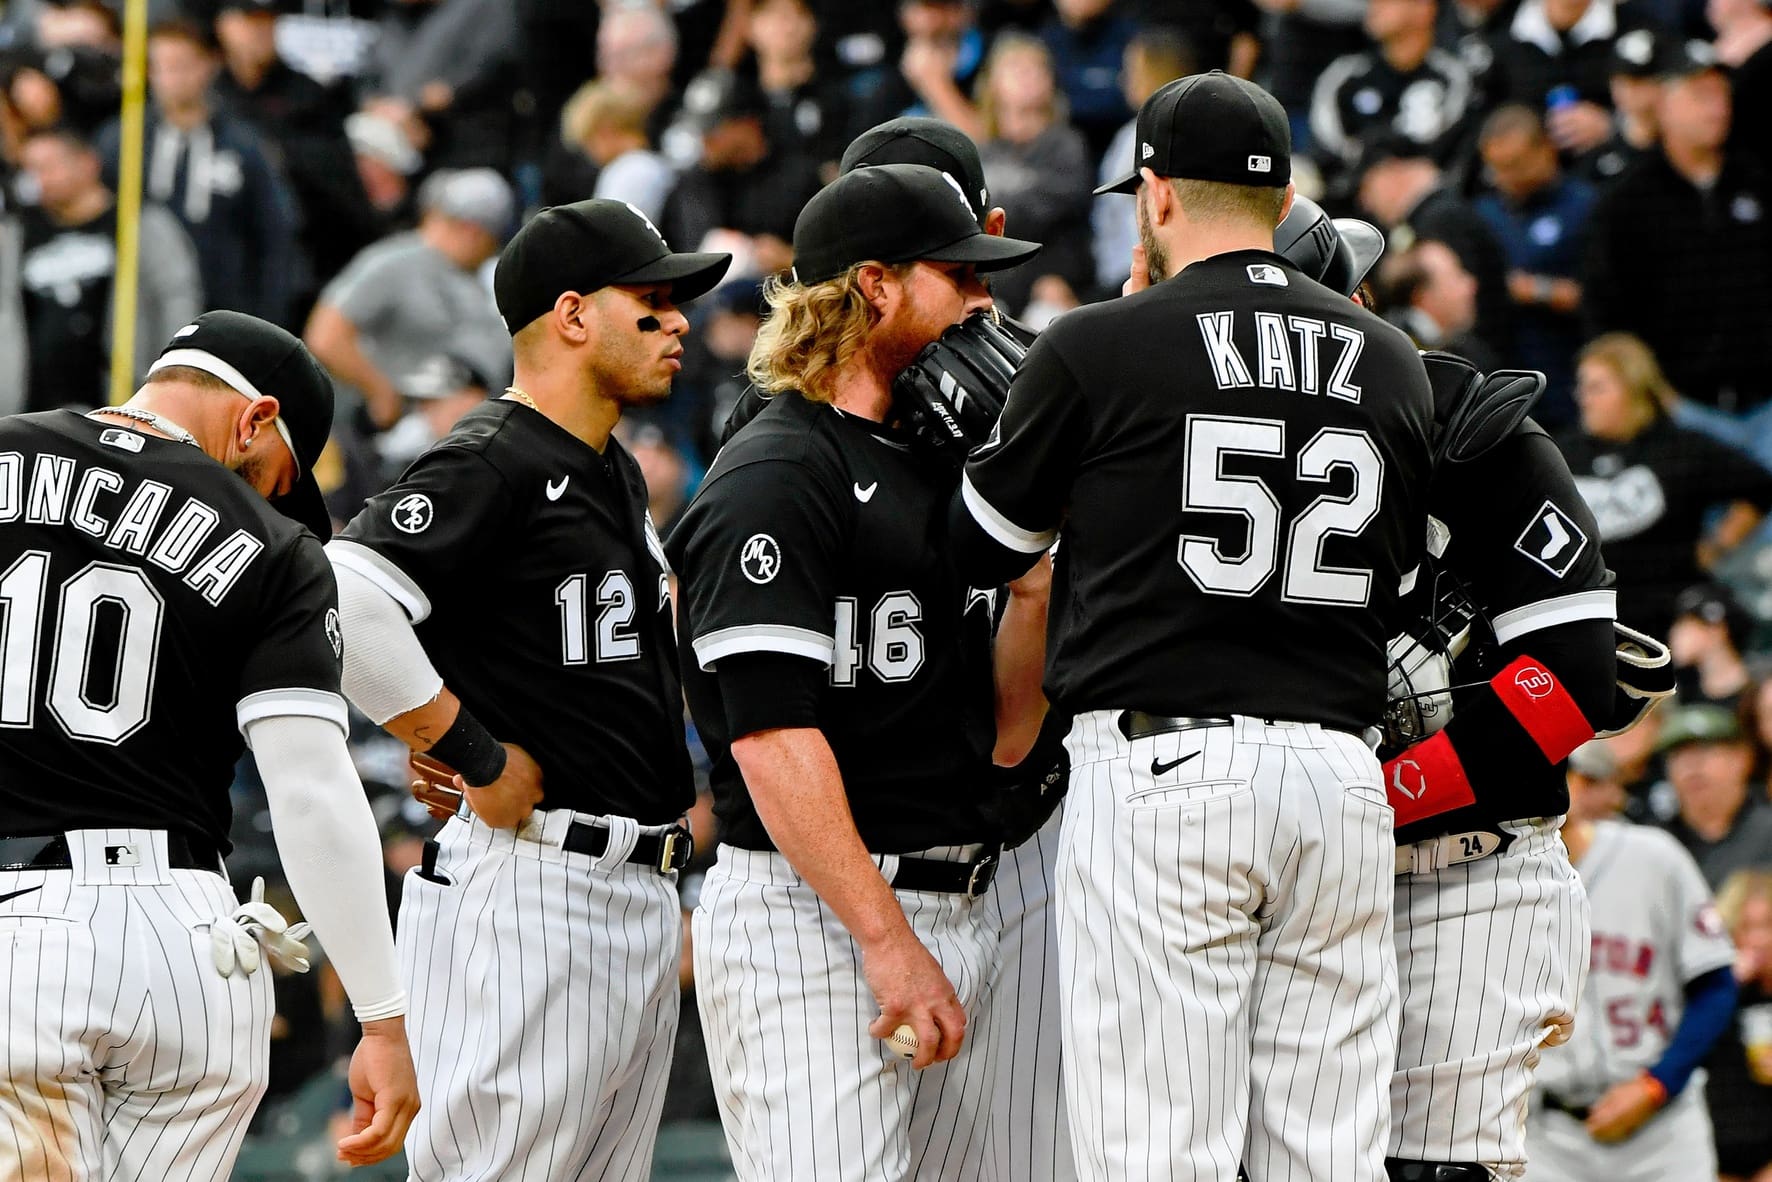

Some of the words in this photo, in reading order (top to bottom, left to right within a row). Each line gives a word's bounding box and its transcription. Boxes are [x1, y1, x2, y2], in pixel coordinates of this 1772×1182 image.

[1196, 311, 1365, 404] KATZ
[1177, 413, 1384, 608] 52
[743, 539, 775, 579] MR
[0, 550, 165, 746] 10
[555, 569, 640, 665] 12
[830, 590, 925, 687] 46
[1460, 835, 1482, 857] 24
